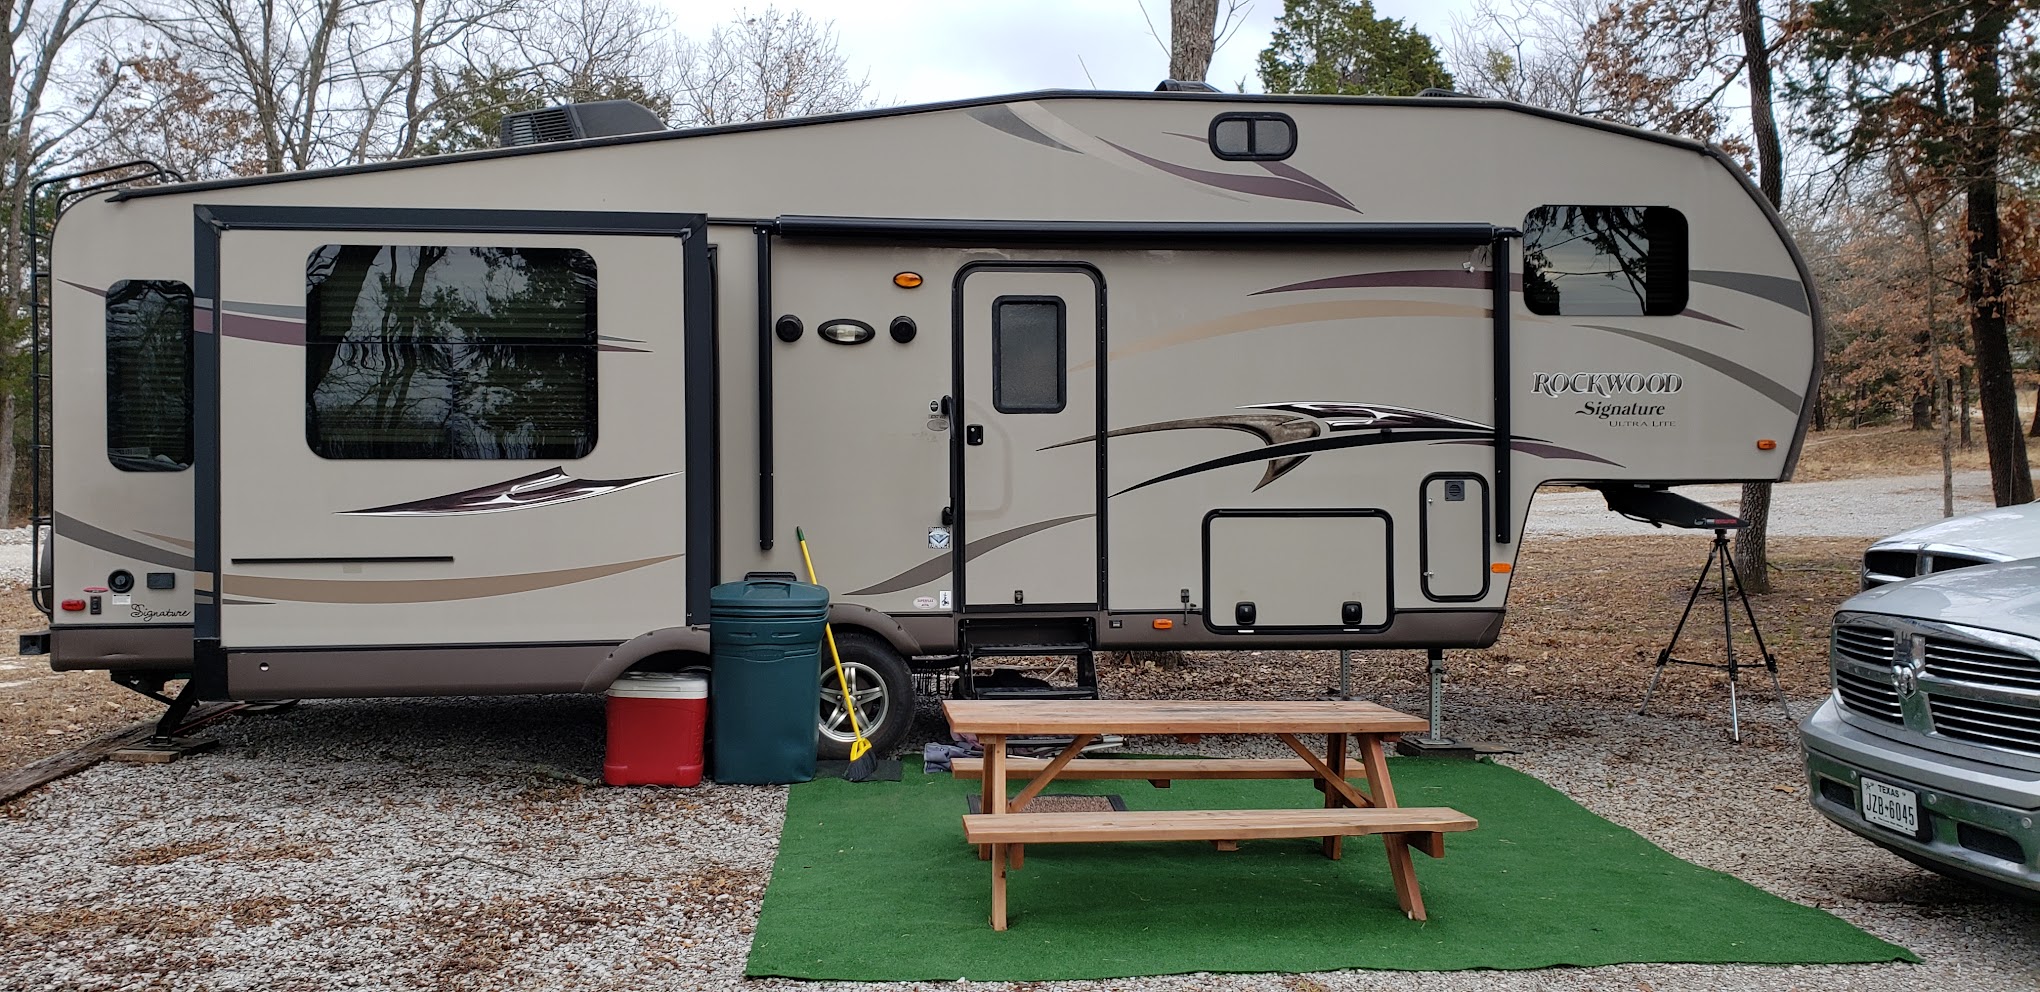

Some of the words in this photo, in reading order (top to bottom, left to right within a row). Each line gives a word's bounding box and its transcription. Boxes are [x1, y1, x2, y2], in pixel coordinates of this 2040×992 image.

[1531, 372, 1683, 398] ROCKWOOD
[1575, 401, 1665, 419] Signature
[131, 603, 191, 622] Signature
[1878, 784, 1900, 798] TEXAS
